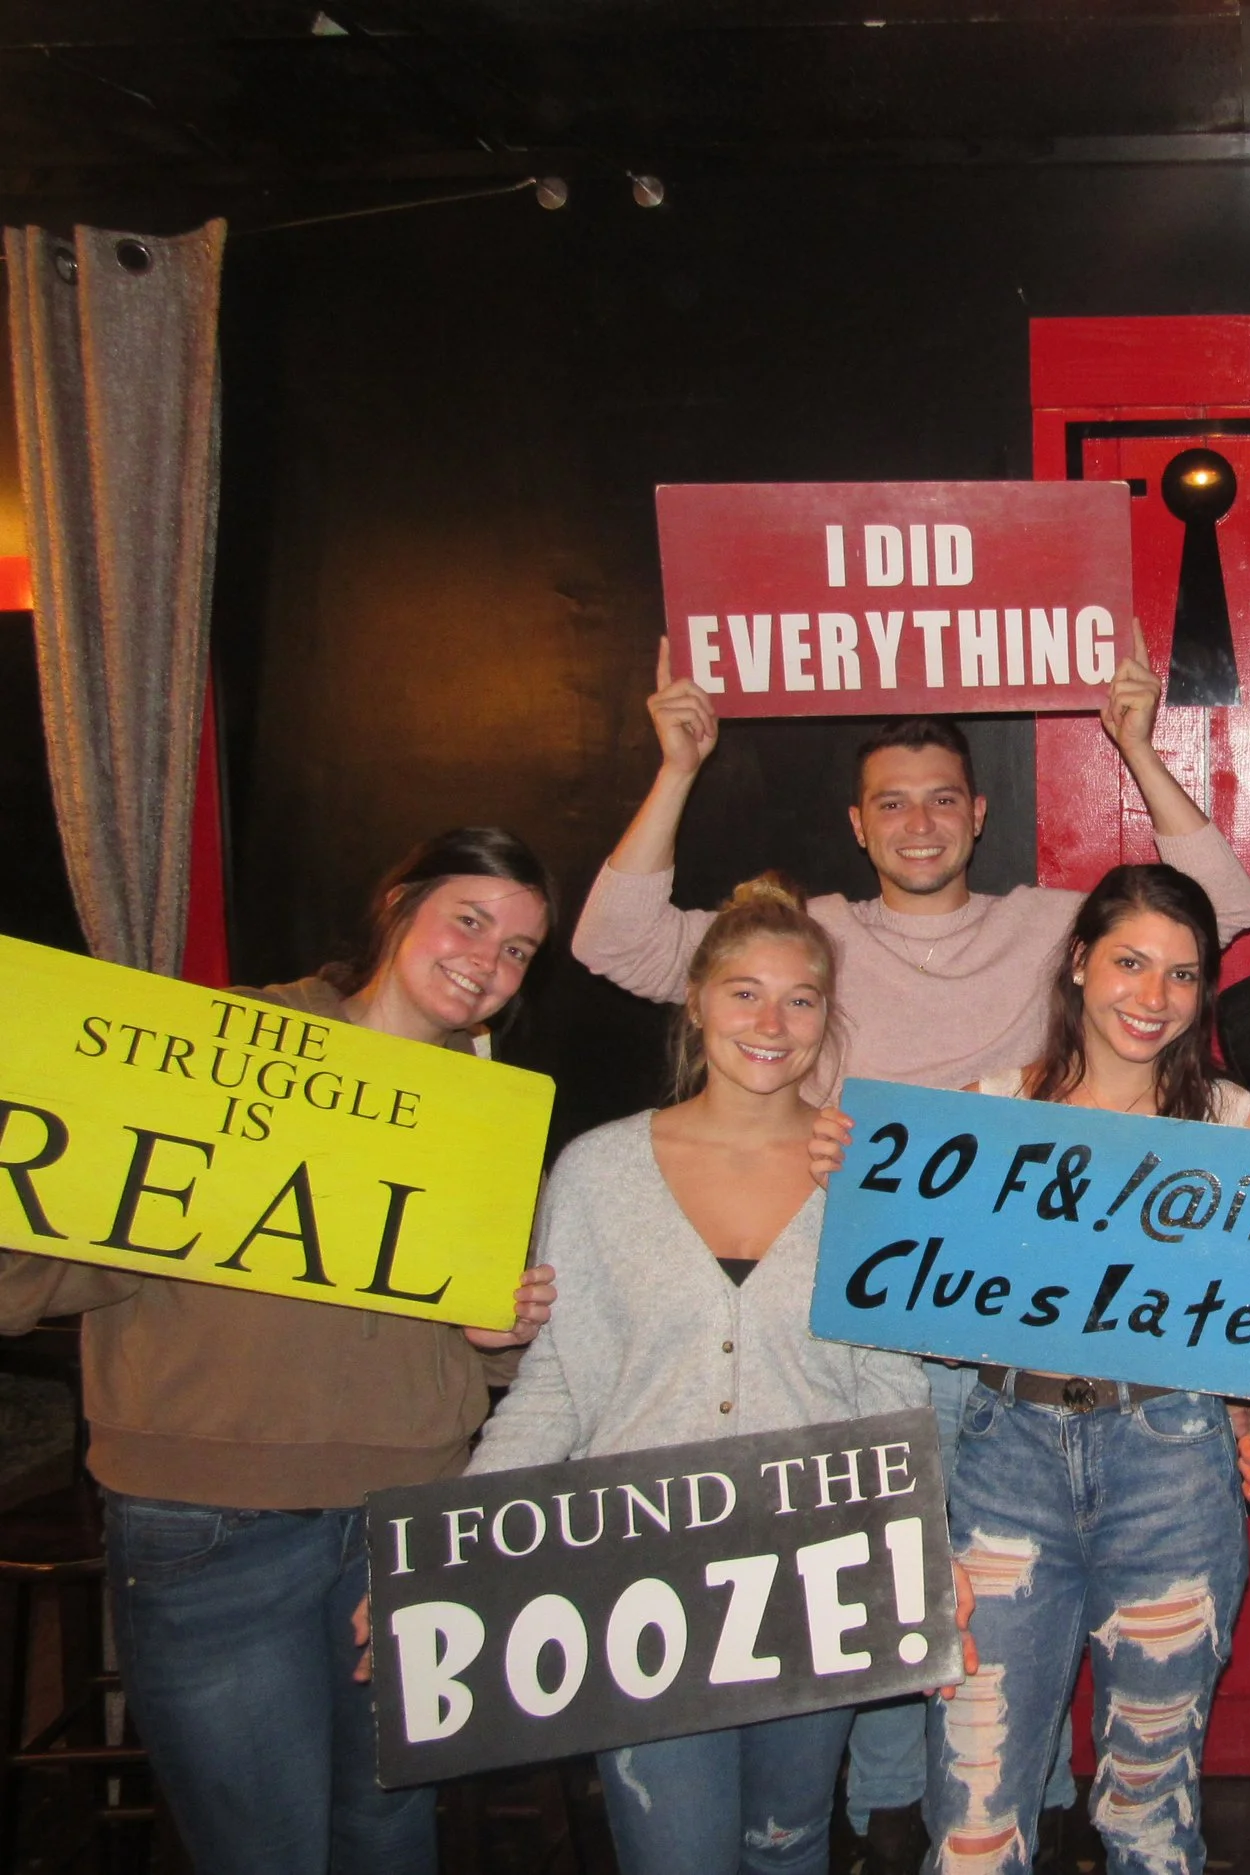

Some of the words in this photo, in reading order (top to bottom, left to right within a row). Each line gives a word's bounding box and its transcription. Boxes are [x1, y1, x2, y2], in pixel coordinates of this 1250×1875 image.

[826, 525, 846, 587] I
[865, 524, 973, 587] DID
[688, 606, 1116, 694] EVERYTHING
[75, 1016, 421, 1130] STRUGGLE
[210, 999, 331, 1061] THE
[217, 1096, 274, 1142] IS
[859, 1122, 978, 1200] 20
[0, 1102, 454, 1305] REAL
[845, 1237, 1070, 1327] Clues
[389, 1517, 416, 1576] I
[442, 1471, 737, 1568] FOUND
[760, 1441, 917, 1515] THE
[391, 1516, 928, 1744] BOOZE!
